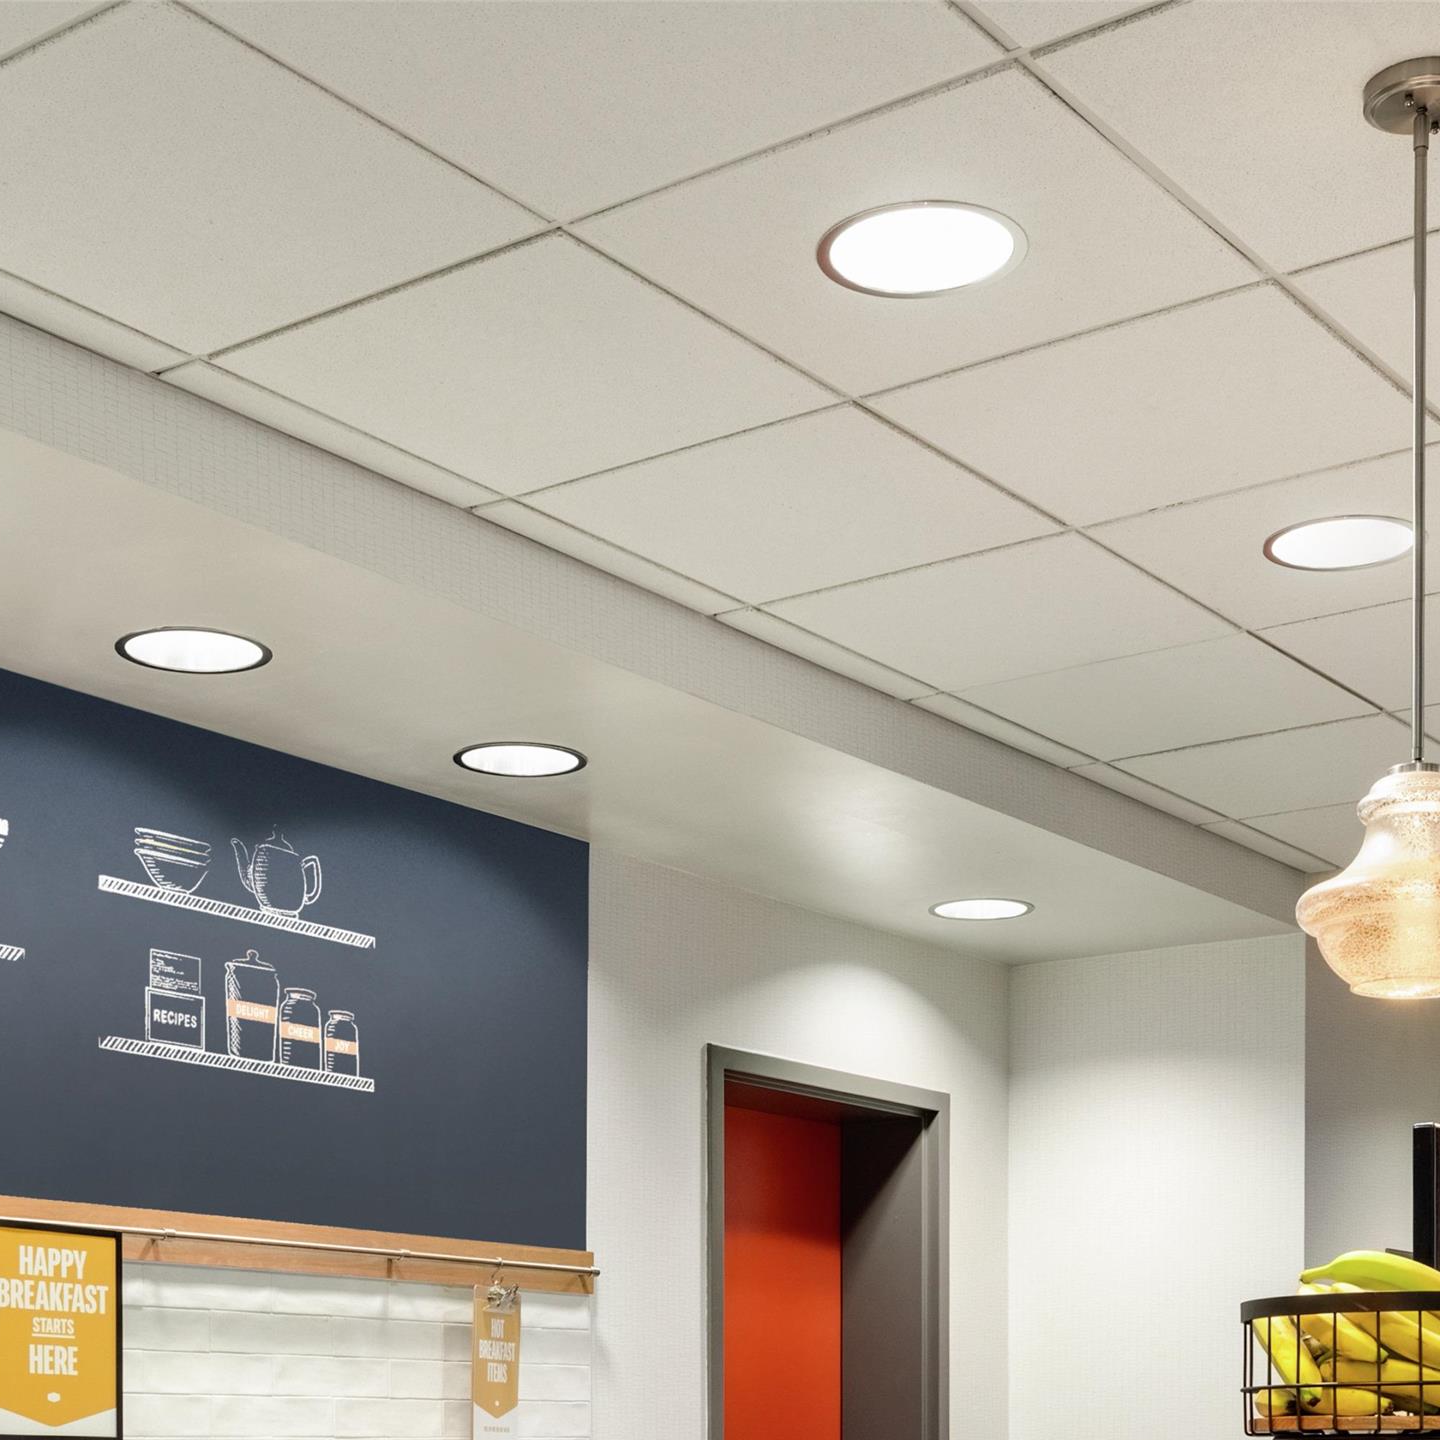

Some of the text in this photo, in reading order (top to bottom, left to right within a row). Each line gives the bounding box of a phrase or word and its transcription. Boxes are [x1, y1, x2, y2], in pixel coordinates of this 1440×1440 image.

[153, 1008, 198, 1029] RECIPES
[235, 1004, 270, 1019] DELIGHT
[287, 1026, 314, 1039] CHEER
[335, 1041, 350, 1052] JOY
[19, 1245, 87, 1280] HAPPY
[32, 1317, 74, 1334] STARTS
[491, 1319, 505, 1339] HOT
[29, 1344, 78, 1376] HERE
[479, 1339, 515, 1361] BREAKFAST
[487, 1362, 508, 1383] ITEMS
